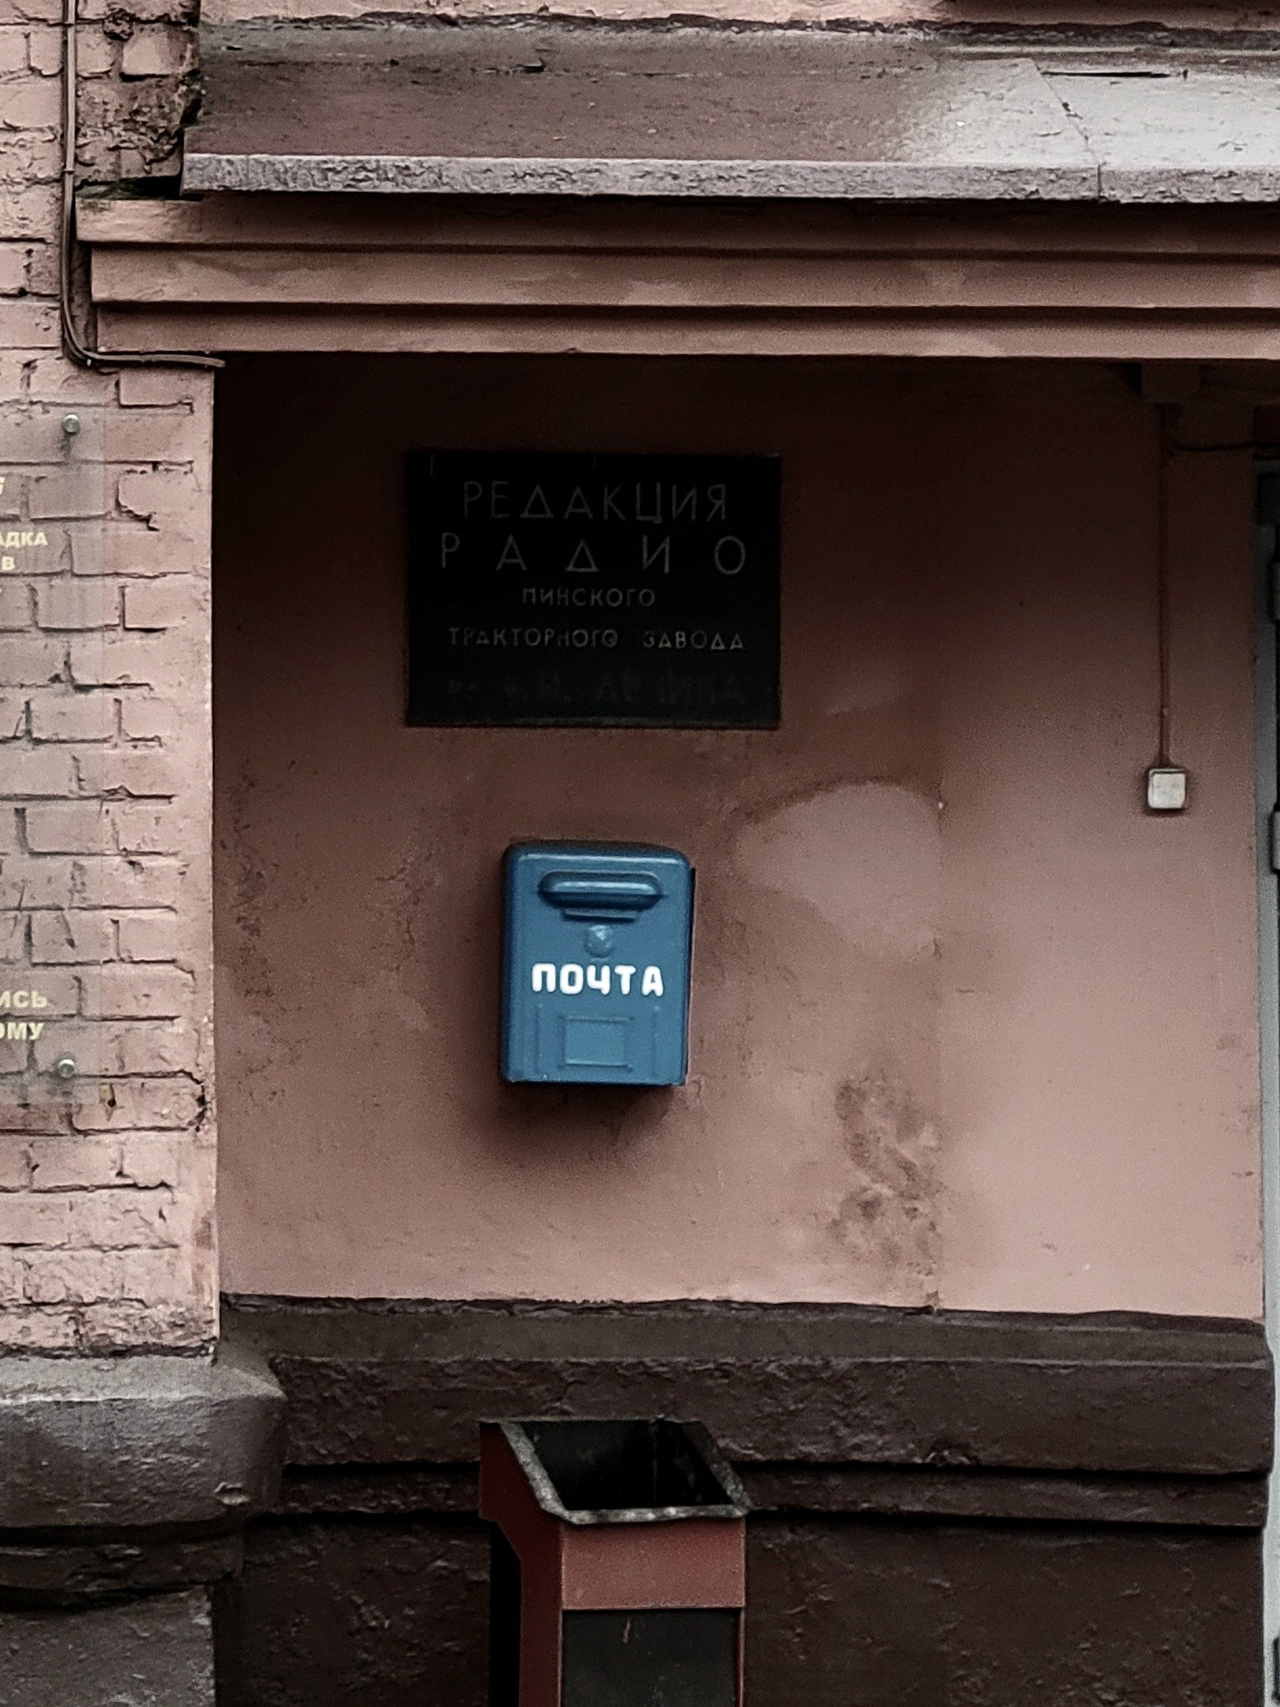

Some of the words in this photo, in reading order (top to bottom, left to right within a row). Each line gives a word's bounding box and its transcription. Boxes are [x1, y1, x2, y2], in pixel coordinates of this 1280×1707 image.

[463, 480, 726, 524] РЕДАКЦИЯ
[1, 556, 16, 571] В
[441, 532, 746, 575] РАДИО
[449, 627, 619, 648] ТРАКТОРНОГО
[642, 630, 745, 651] ЗАВОДА
[532, 963, 664, 997] ПОЧТА
